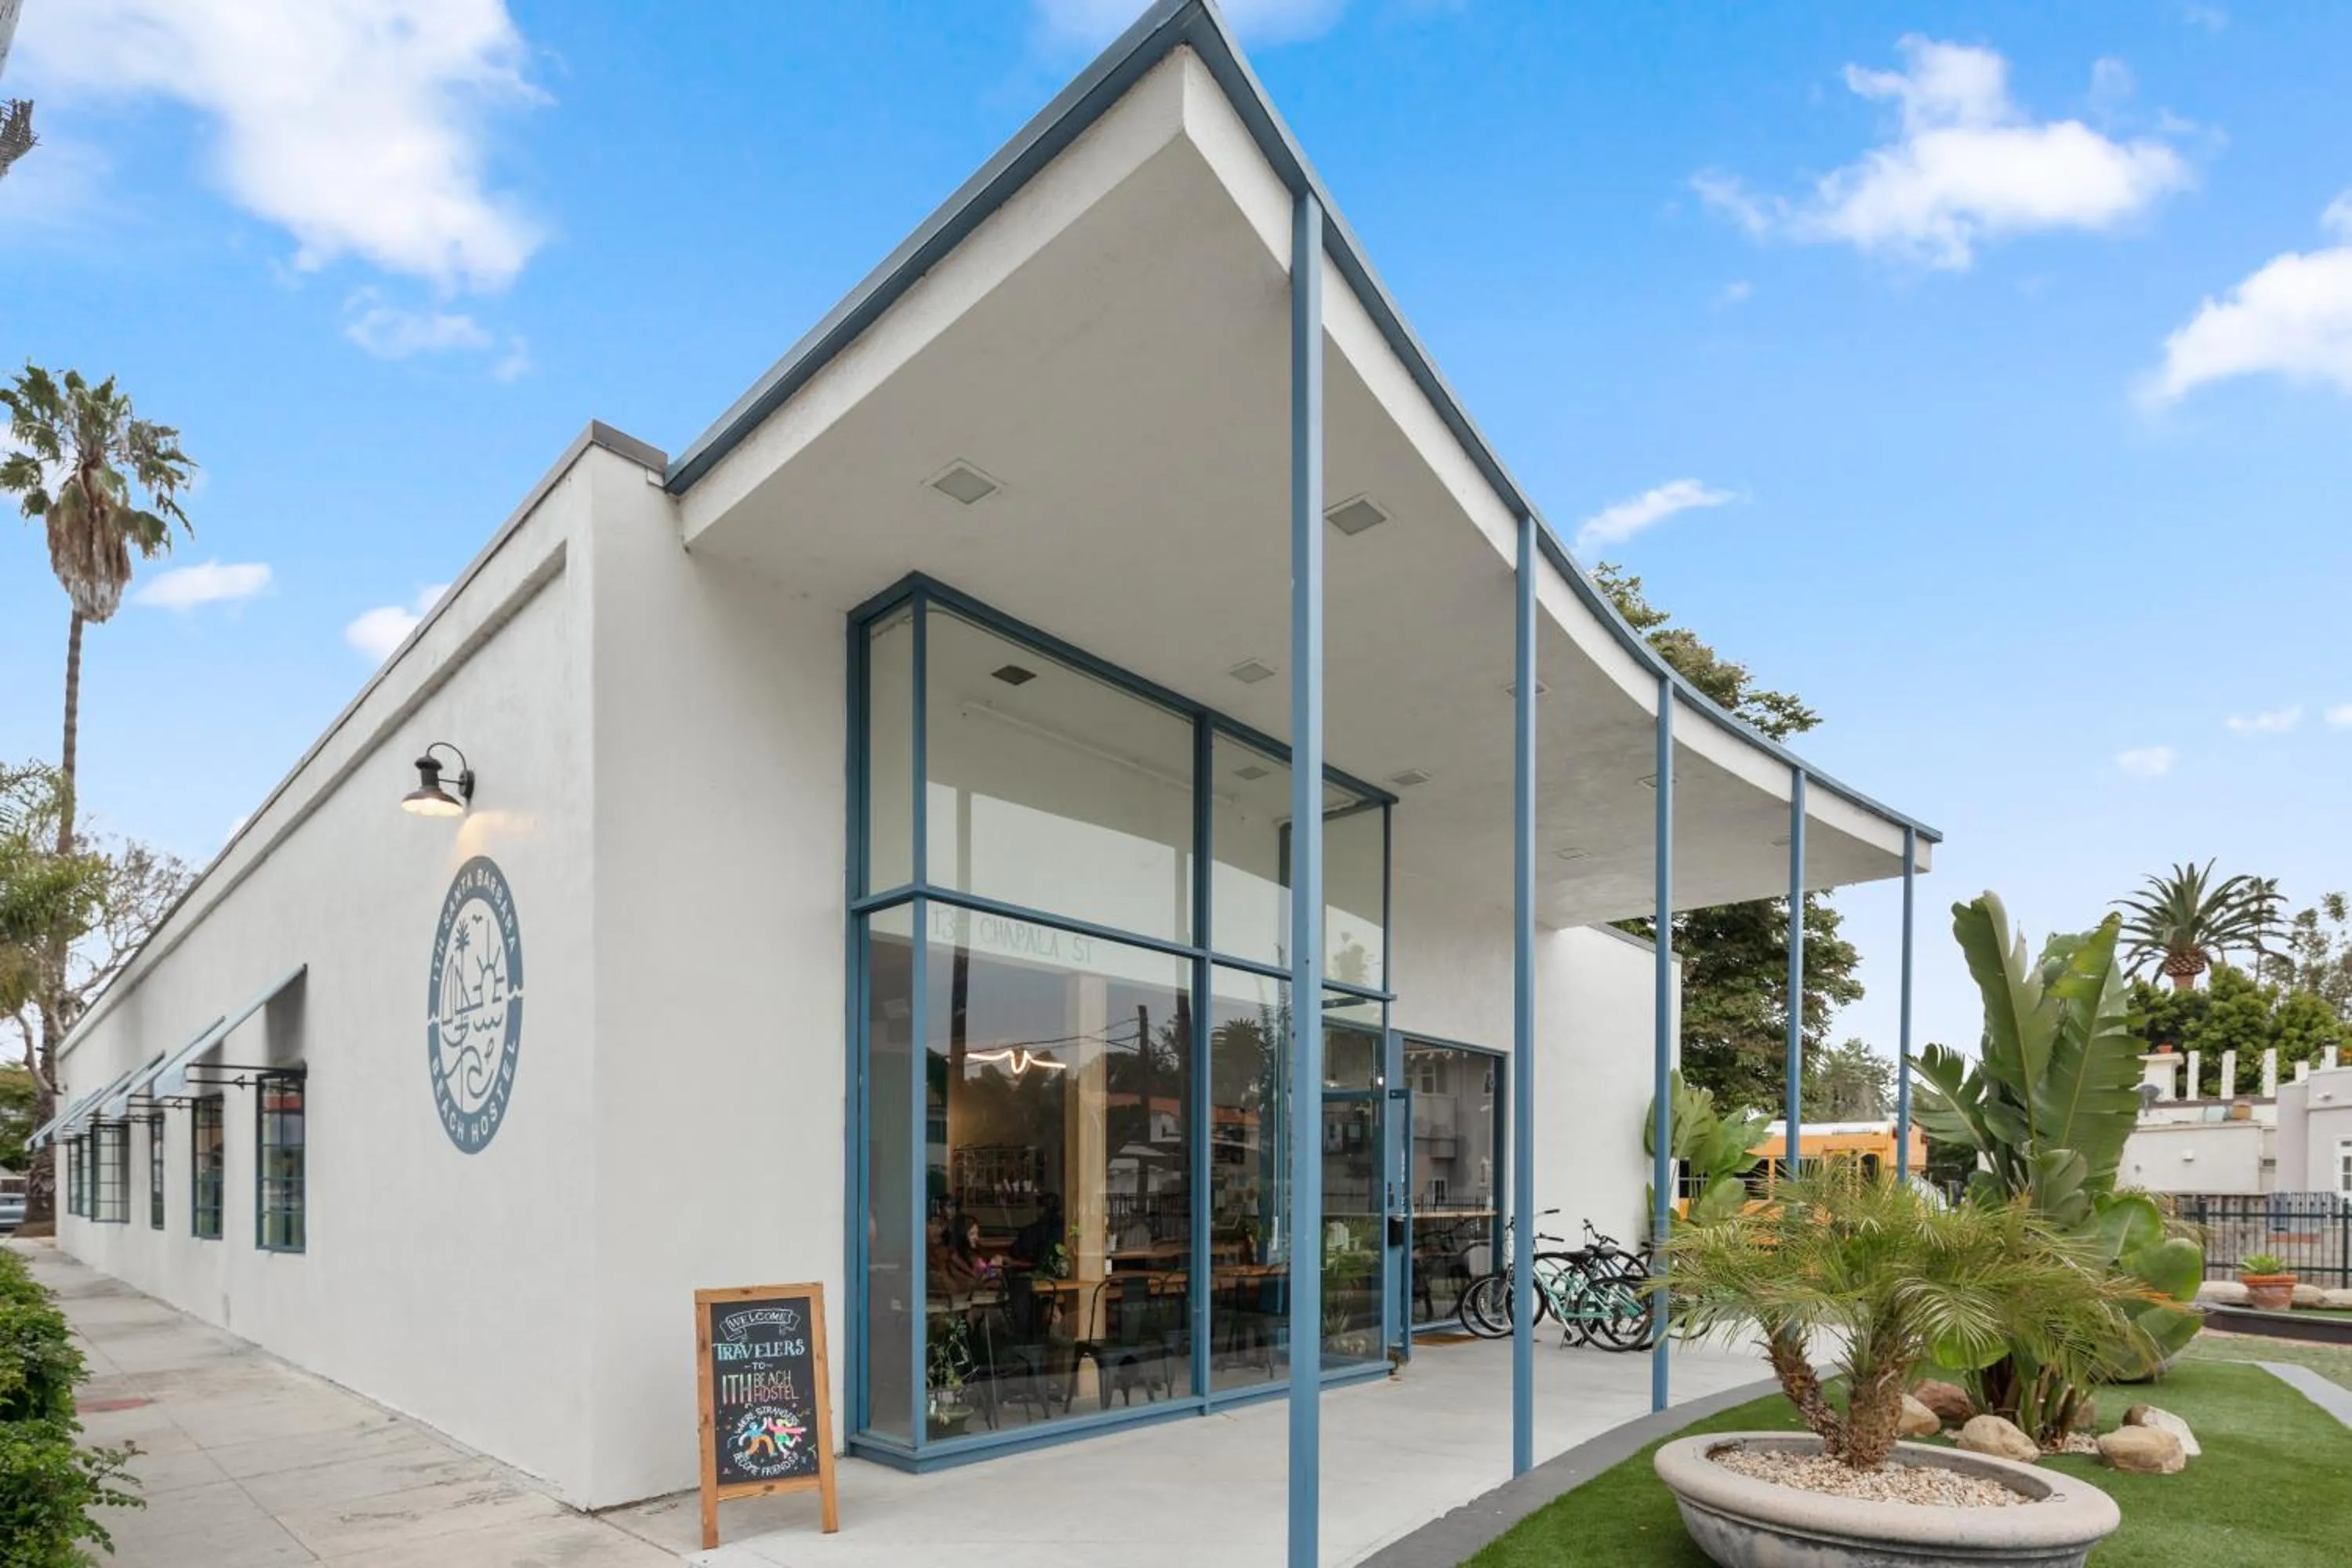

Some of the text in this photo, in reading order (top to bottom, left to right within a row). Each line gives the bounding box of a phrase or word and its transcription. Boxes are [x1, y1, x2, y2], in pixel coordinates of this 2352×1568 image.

[444, 872, 473, 930] SANTA
[476, 867, 516, 955] BARBARA
[979, 916, 1059, 958] CHAPALA
[1072, 936, 1095, 964] ST
[432, 1040, 517, 1142] BEACH HOSTEL
[728, 1312, 786, 1328] WELCOME
[713, 1338, 806, 1361] TRAVELERS
[722, 1373, 753, 1405] ITH
[754, 1370, 792, 1386] BEACH
[753, 1385, 800, 1403] HOSTEL
